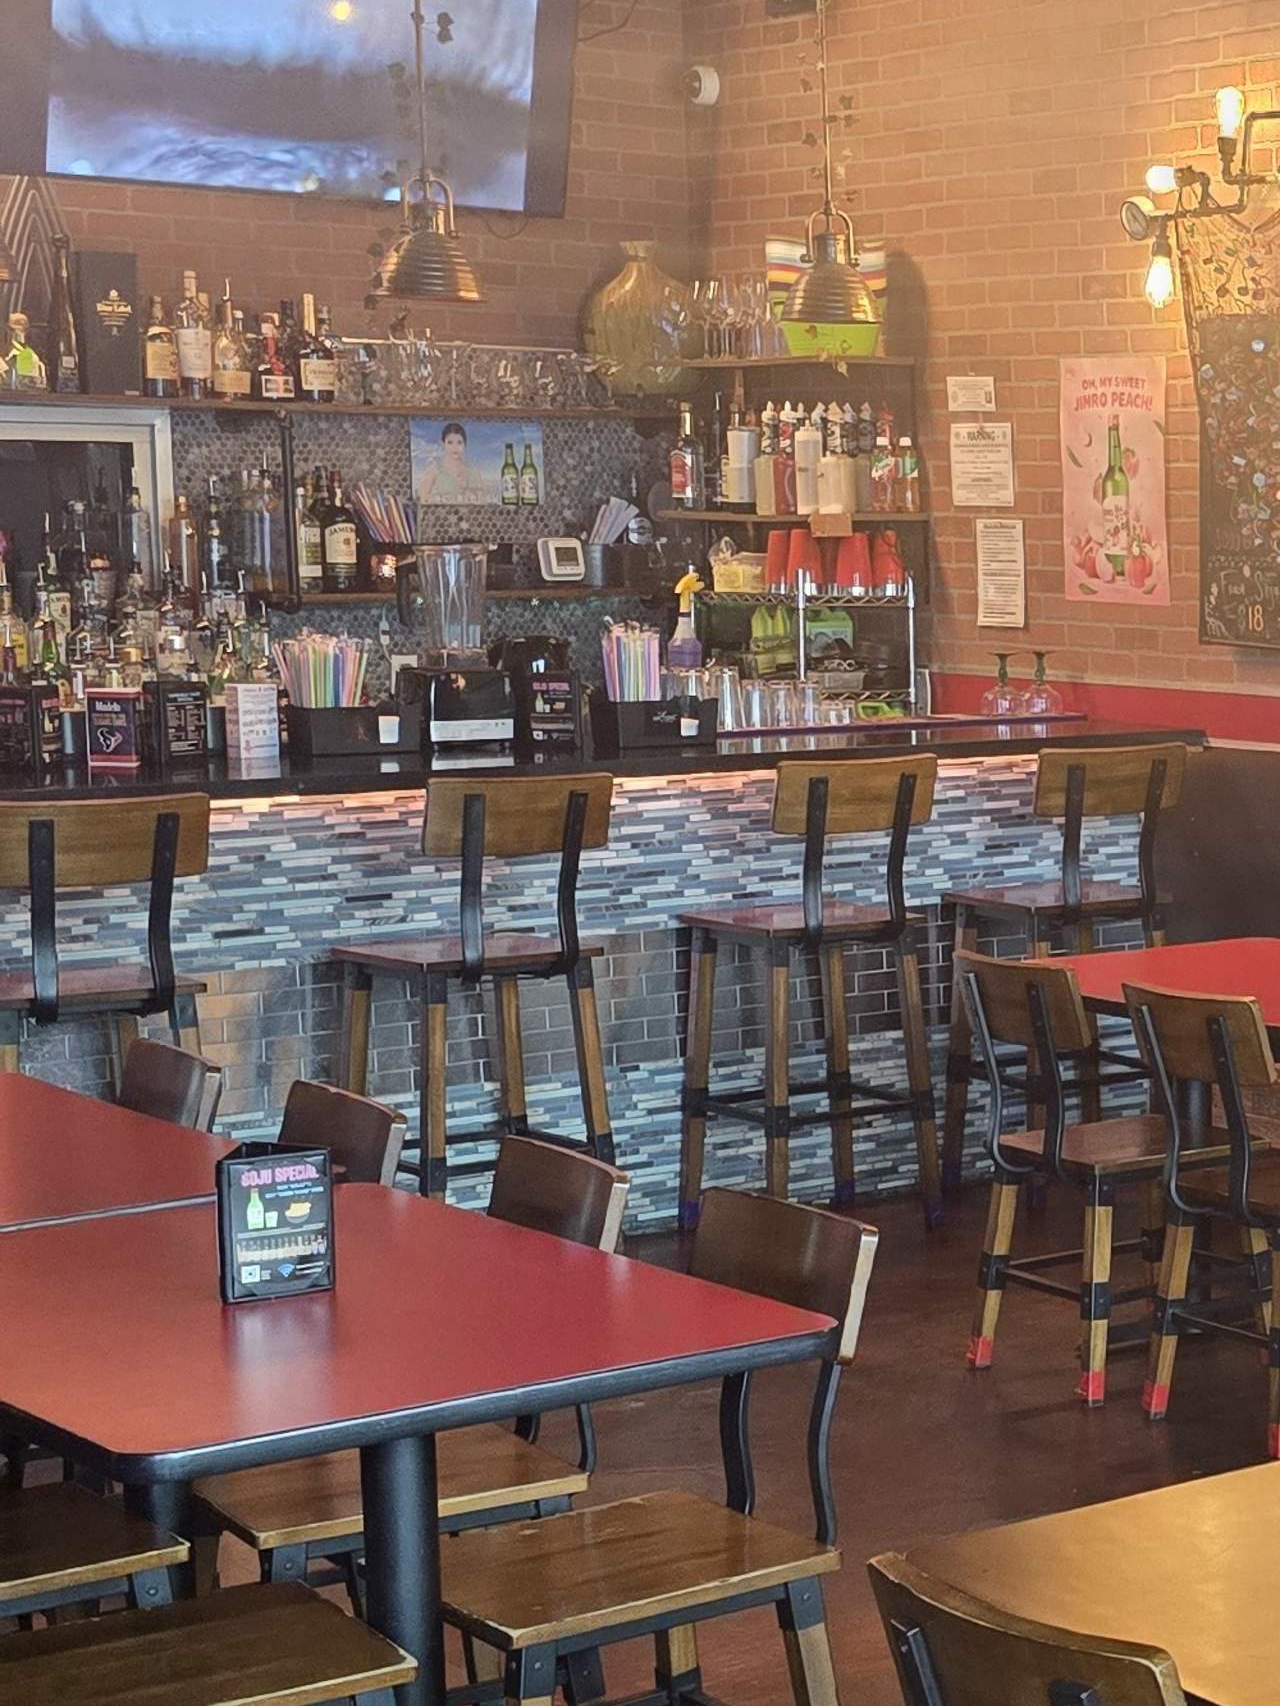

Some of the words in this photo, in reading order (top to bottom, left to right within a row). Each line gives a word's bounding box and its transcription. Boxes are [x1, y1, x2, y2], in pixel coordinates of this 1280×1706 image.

[1099, 376, 1113, 388] MY
[1114, 376, 1146, 390] SWEET
[241, 1168, 272, 1187] SOJU
[274, 1163, 320, 1183] SPECIAL
